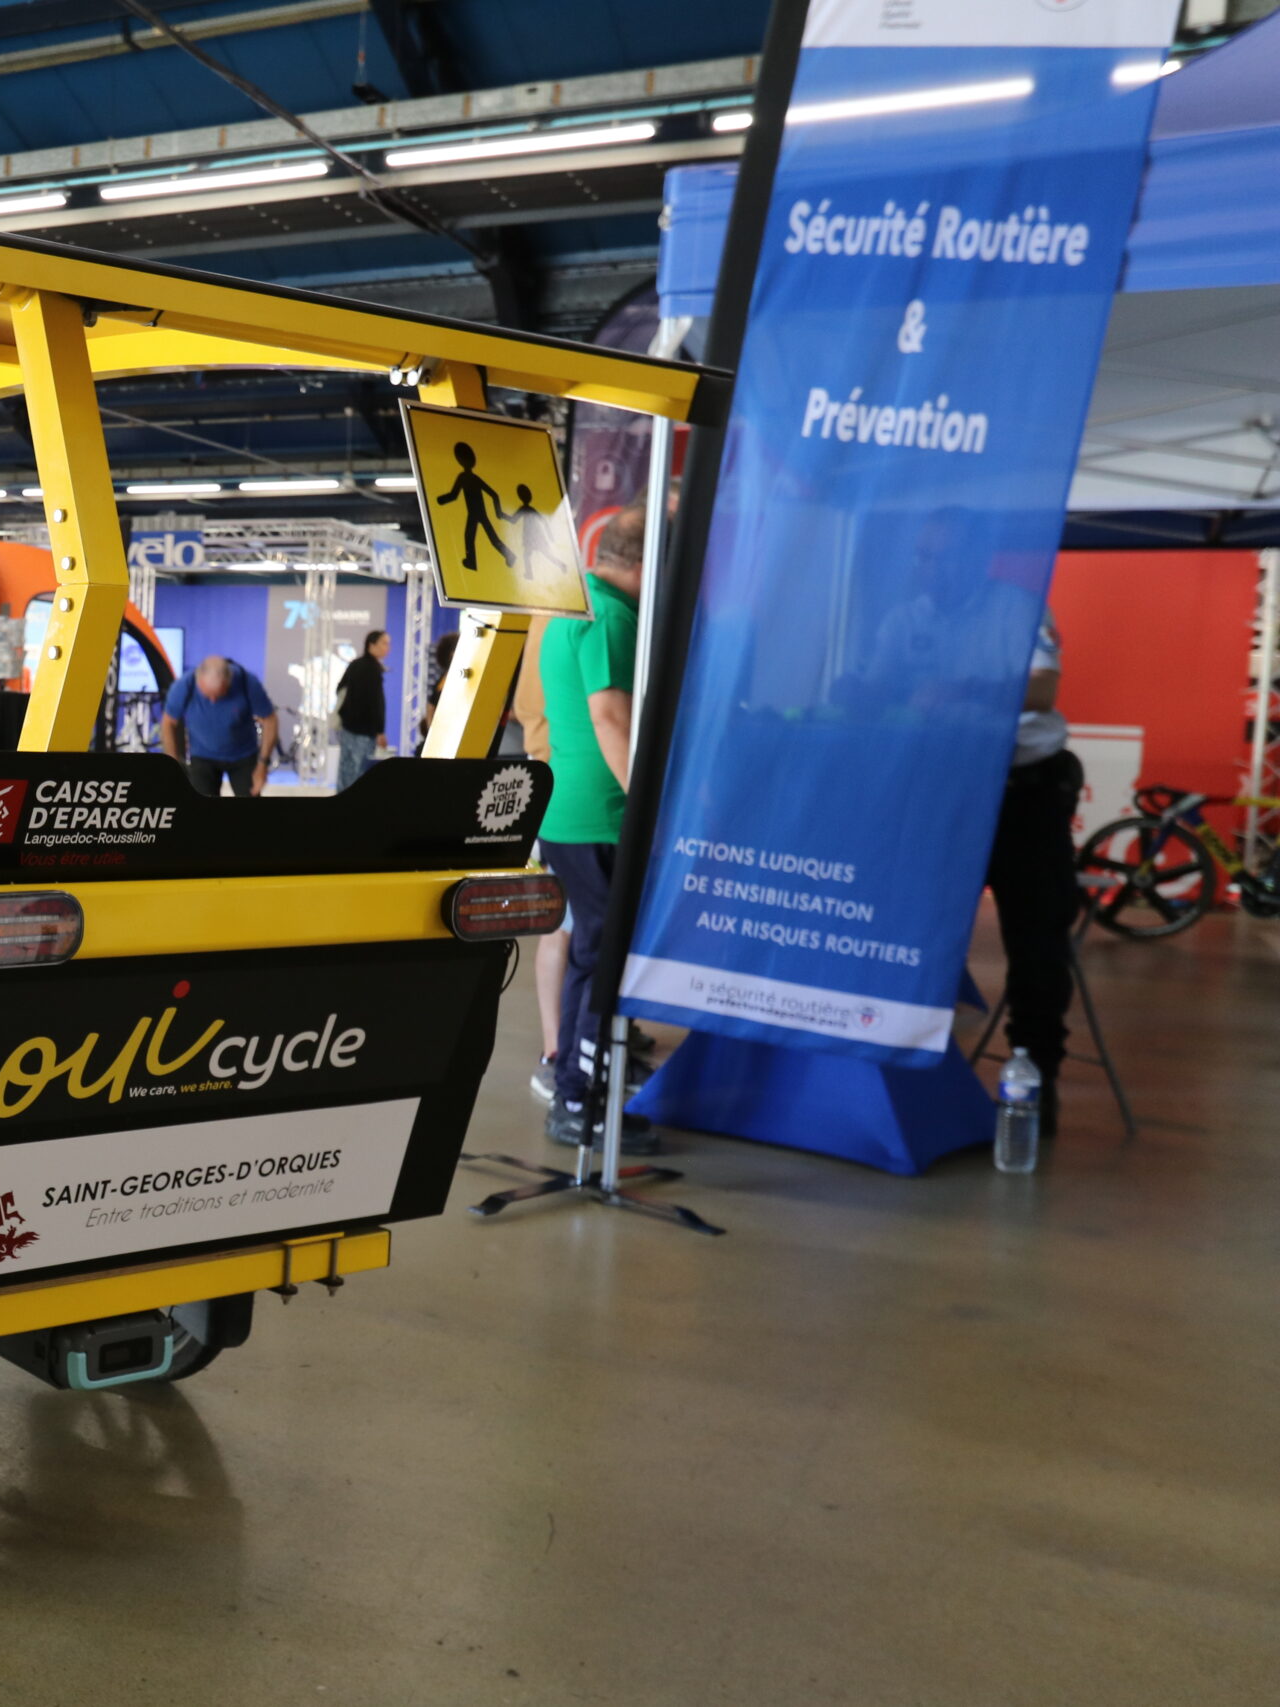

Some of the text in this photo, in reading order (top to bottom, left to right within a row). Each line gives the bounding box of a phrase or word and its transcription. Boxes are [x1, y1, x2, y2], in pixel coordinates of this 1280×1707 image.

[784, 199, 1090, 266] Sécurité Routière
[897, 299, 927, 354] &
[801, 386, 988, 453] Prévention
[35, 780, 132, 803] CAISSE
[492, 778, 524, 793] Toute
[493, 791, 518, 803] votre
[23, 831, 156, 847] Languedoc-Roussillon
[28, 807, 176, 829] D'EPARGNE
[19, 850, 57, 866] Vous
[60, 850, 90, 865] être
[674, 837, 856, 883] ACTIONS LUDIQUES
[683, 873, 874, 923] DE SENSIBILISATION
[696, 911, 922, 967] AUX RISQUES ROUTIERS
[690, 976, 851, 1017] la sécurité routière
[129, 1080, 233, 1098] We care, we share.
[42, 1149, 342, 1208] SAINT-GEORGES-D'ORQUES
[85, 1177, 336, 1228] Entre traditions et modernité
